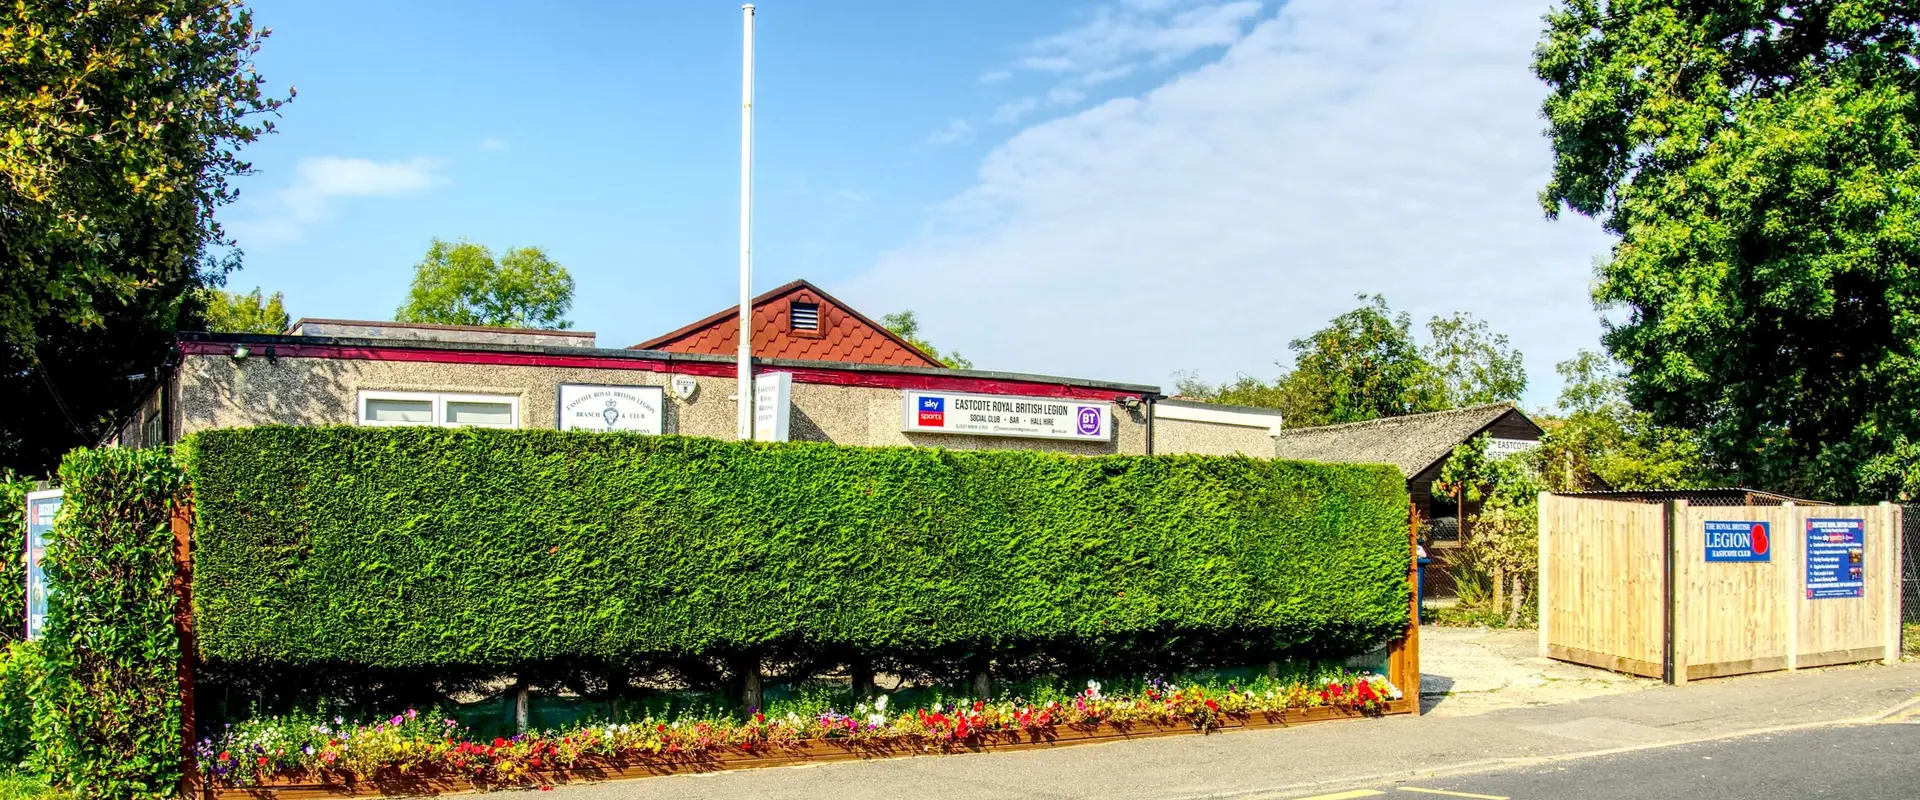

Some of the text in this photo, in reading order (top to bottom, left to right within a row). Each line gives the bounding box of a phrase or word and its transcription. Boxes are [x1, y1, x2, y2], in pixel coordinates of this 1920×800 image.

[566, 394, 592, 411] EASTCOTE
[614, 391, 636, 401] BRITISH
[636, 399, 655, 414] LEGION
[924, 399, 939, 410] sky
[955, 399, 1068, 416] EASTCOTE ROYAL BRITISH LEGION
[970, 414, 987, 422] SOCIAL
[1083, 413, 1095, 423] BT
[1498, 441, 1528, 450] EASTCOTE
[1706, 533, 1751, 548] LEGION
